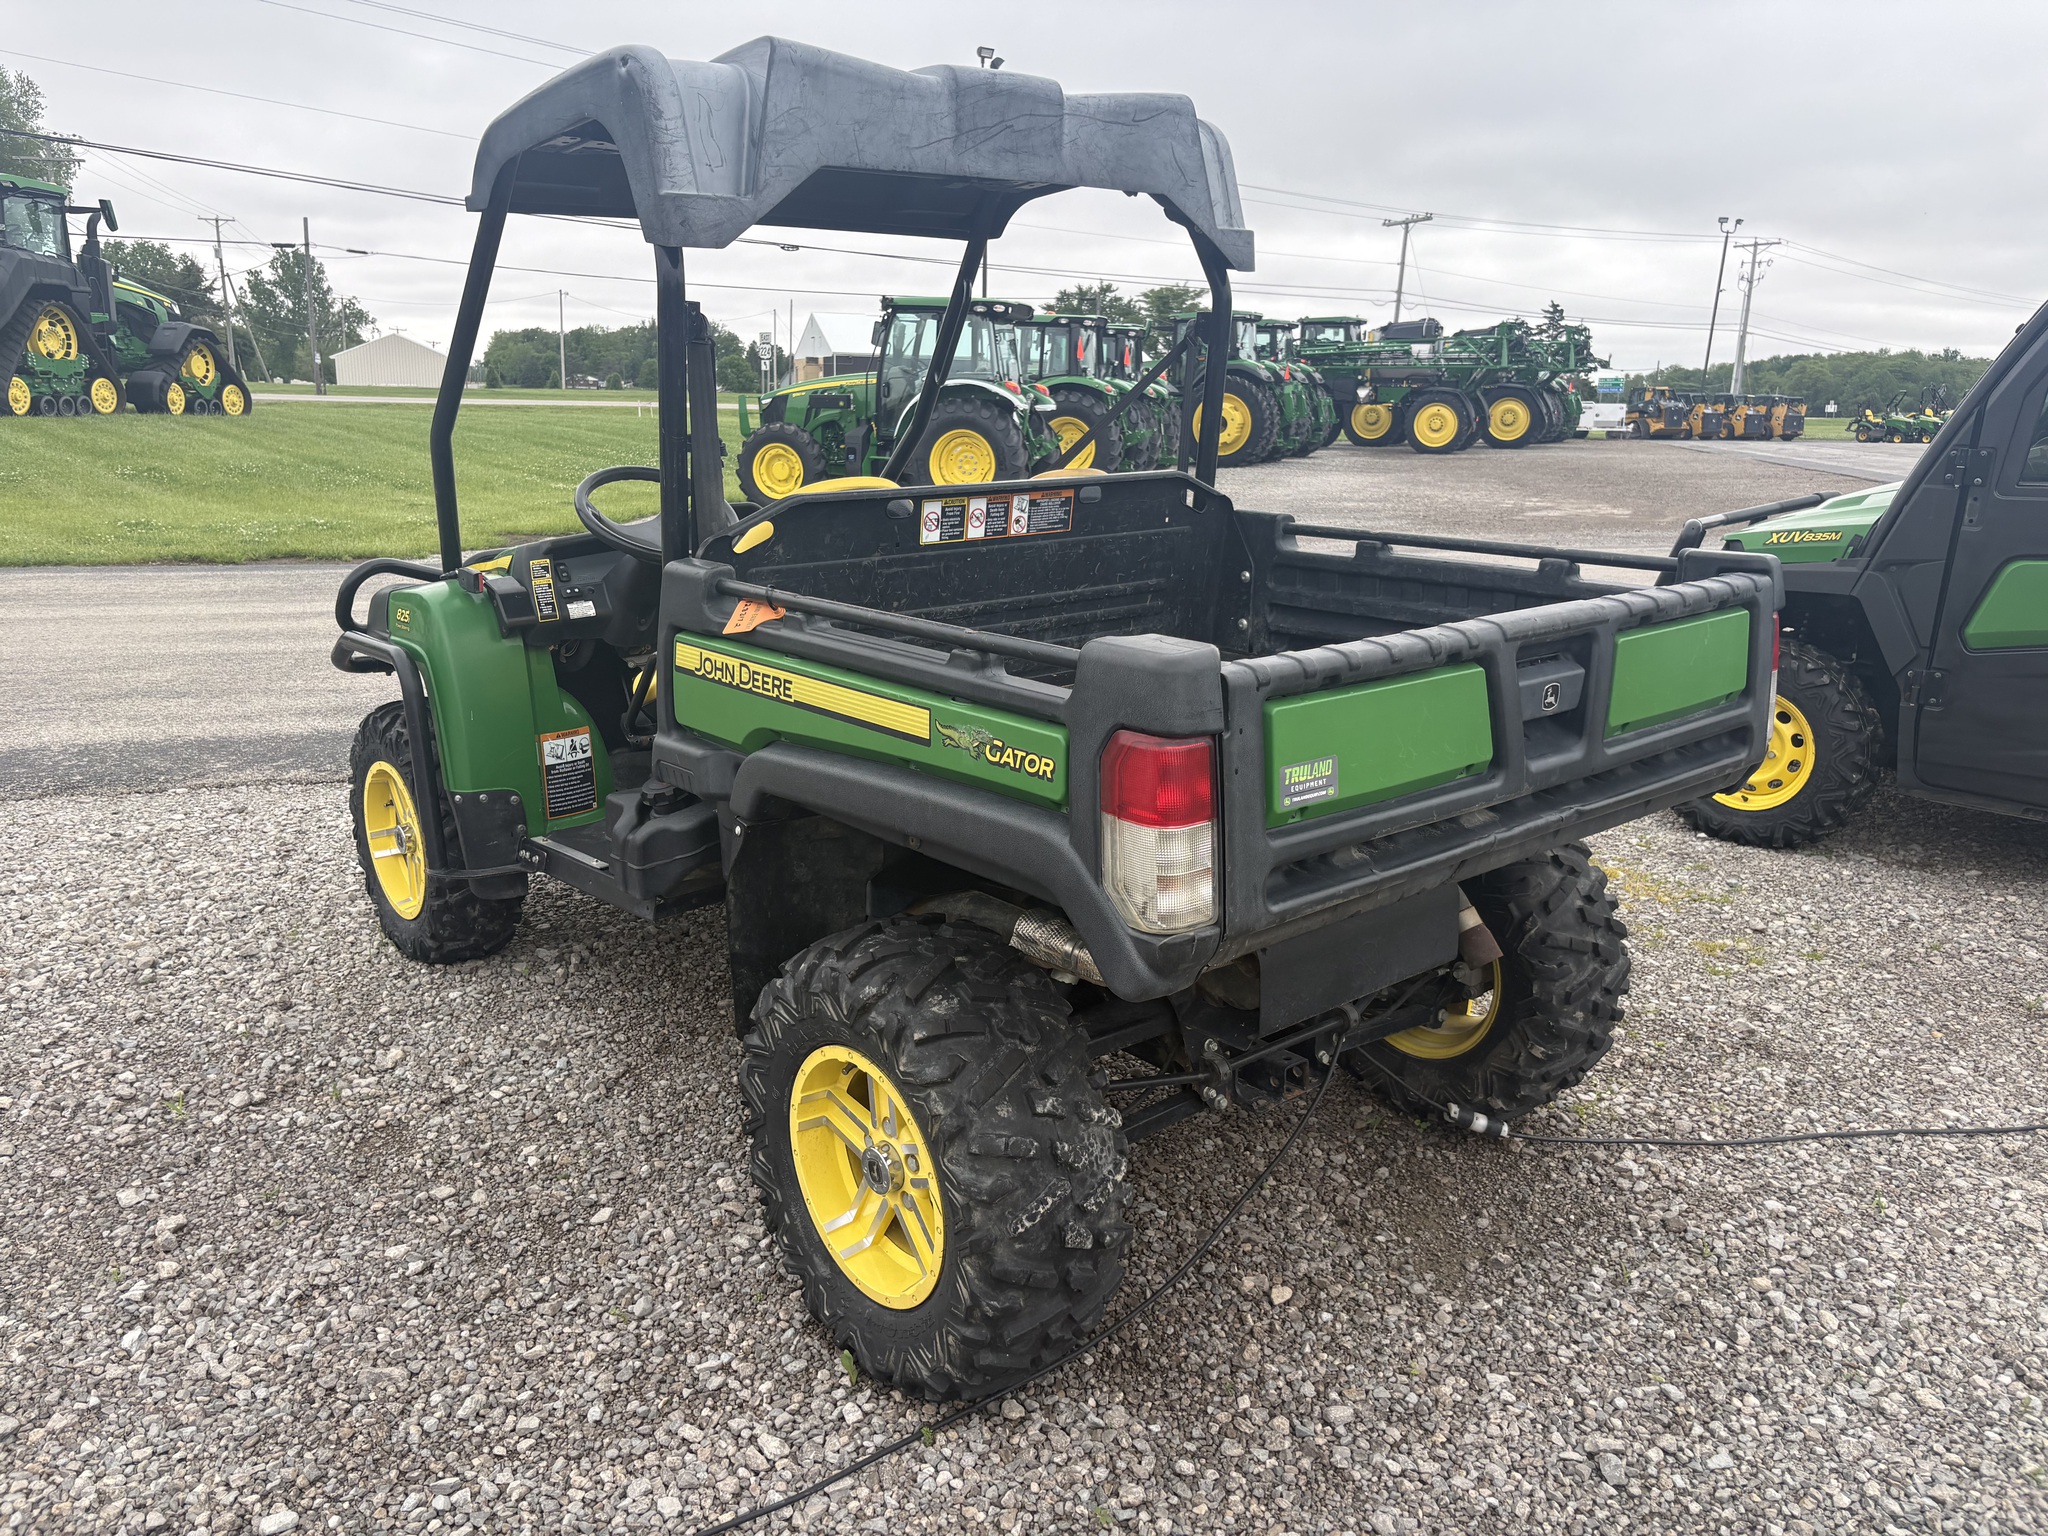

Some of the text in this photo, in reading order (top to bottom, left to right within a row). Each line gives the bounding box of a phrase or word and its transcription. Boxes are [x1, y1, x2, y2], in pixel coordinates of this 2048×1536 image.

[760, 334, 770, 342] EAST
[760, 346, 770, 357] 224
[1764, 531, 1842, 545] XUV835M
[694, 651, 794, 700] JOHN DEERE
[561, 729, 579, 738] WARNING
[985, 740, 1055, 779] GATOR
[1284, 759, 1333, 786] TRULAND
[1291, 778, 1327, 793] EQUIPMENT
